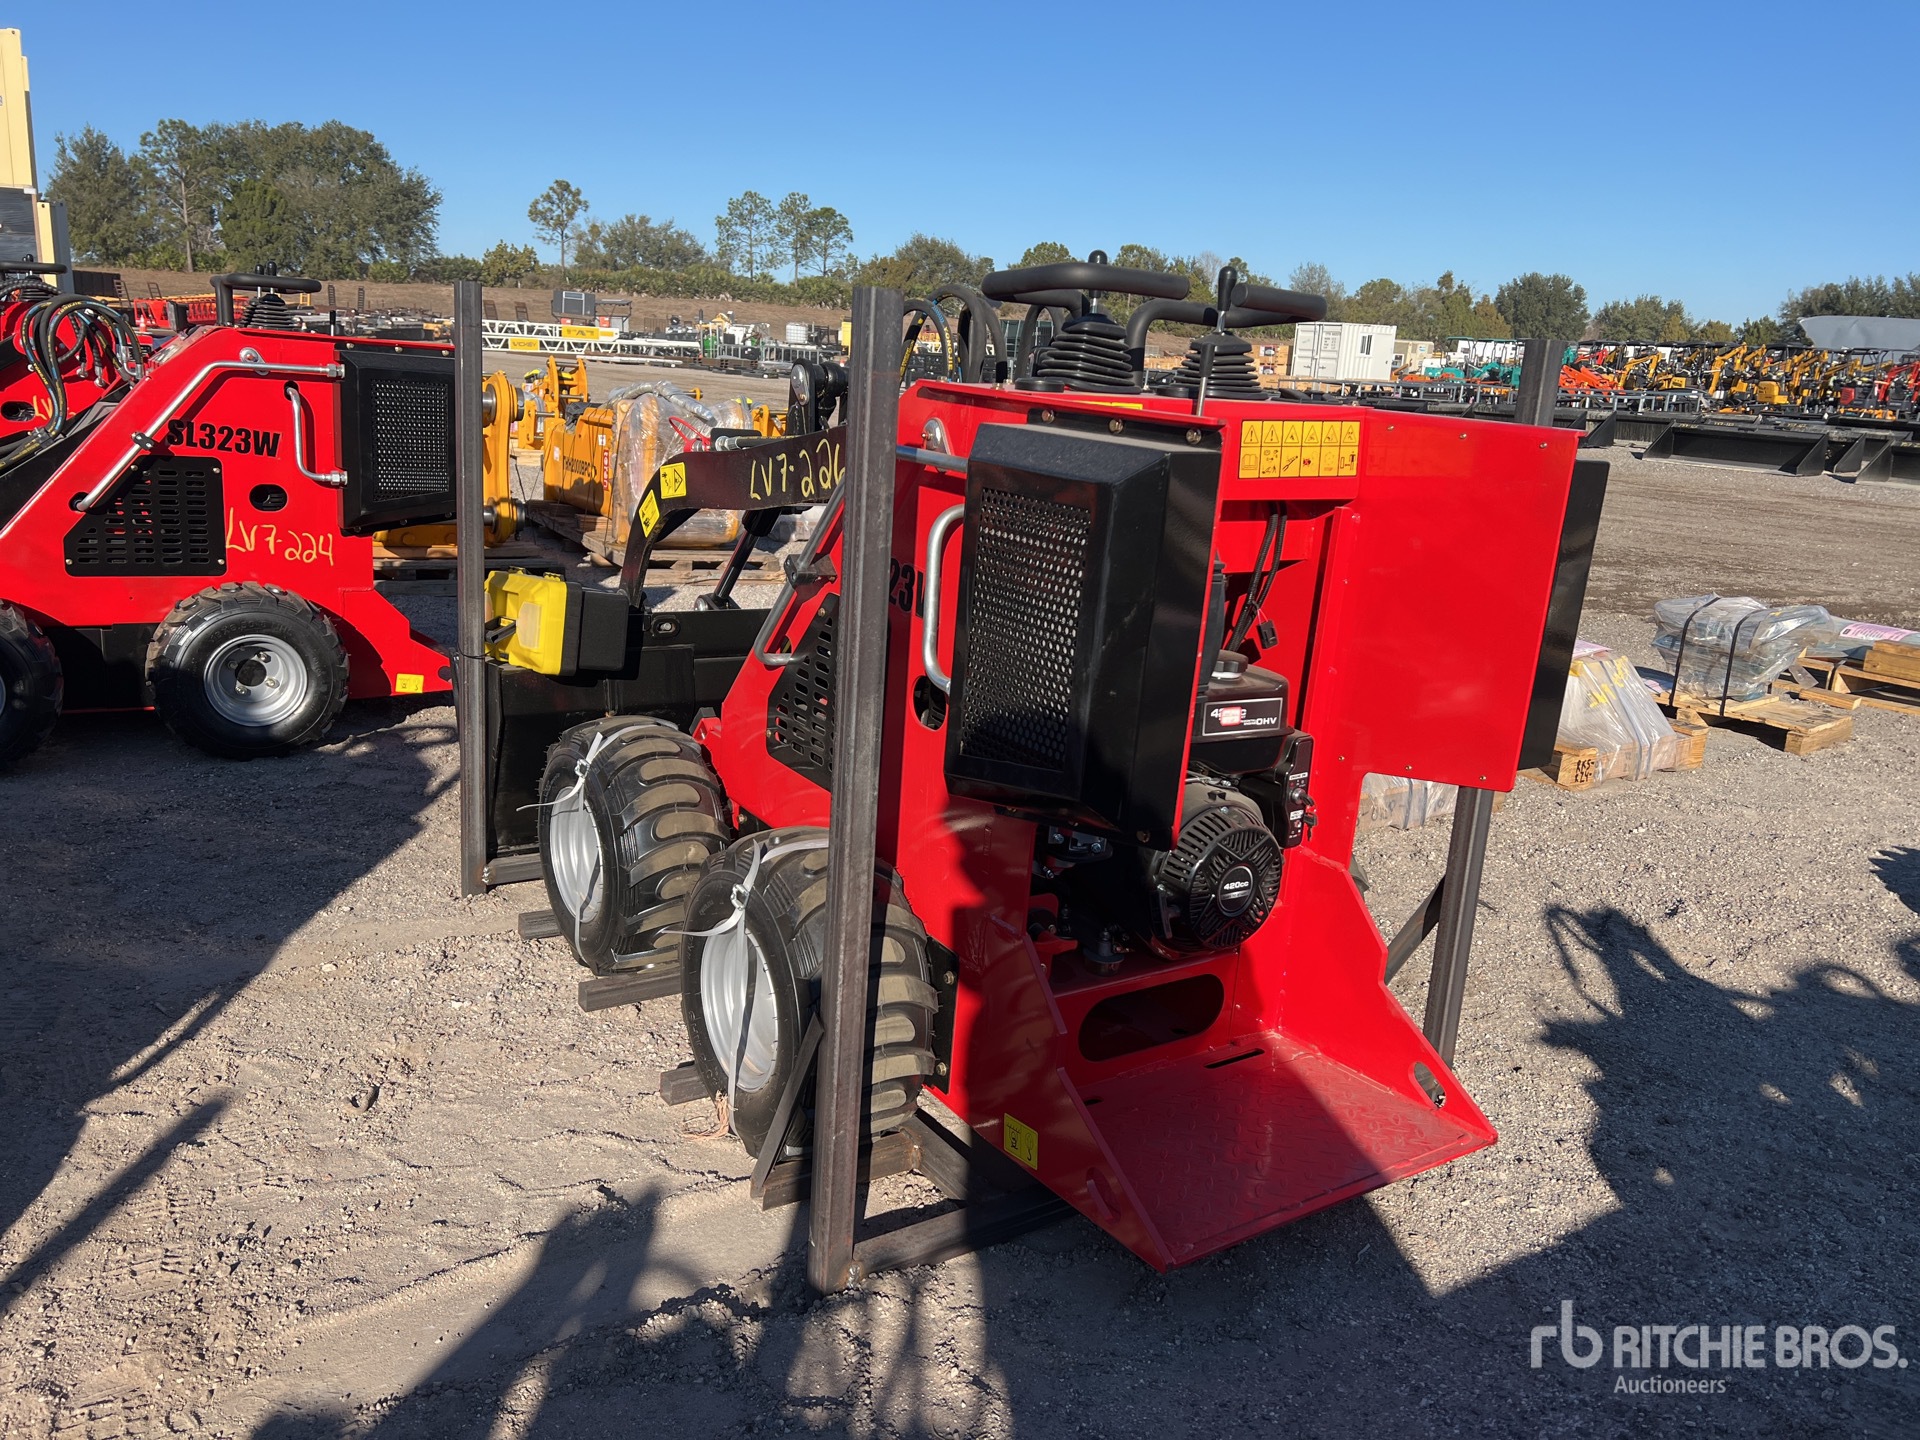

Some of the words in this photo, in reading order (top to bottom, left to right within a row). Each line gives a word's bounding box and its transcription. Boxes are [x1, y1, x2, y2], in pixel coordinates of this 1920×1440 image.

[943, 326, 954, 371] YONGJIE
[166, 419, 281, 458] SL323W
[225, 507, 334, 566] LV7-224
[1256, 717, 1278, 726] OHV
[1223, 881, 1250, 890] 420cc
